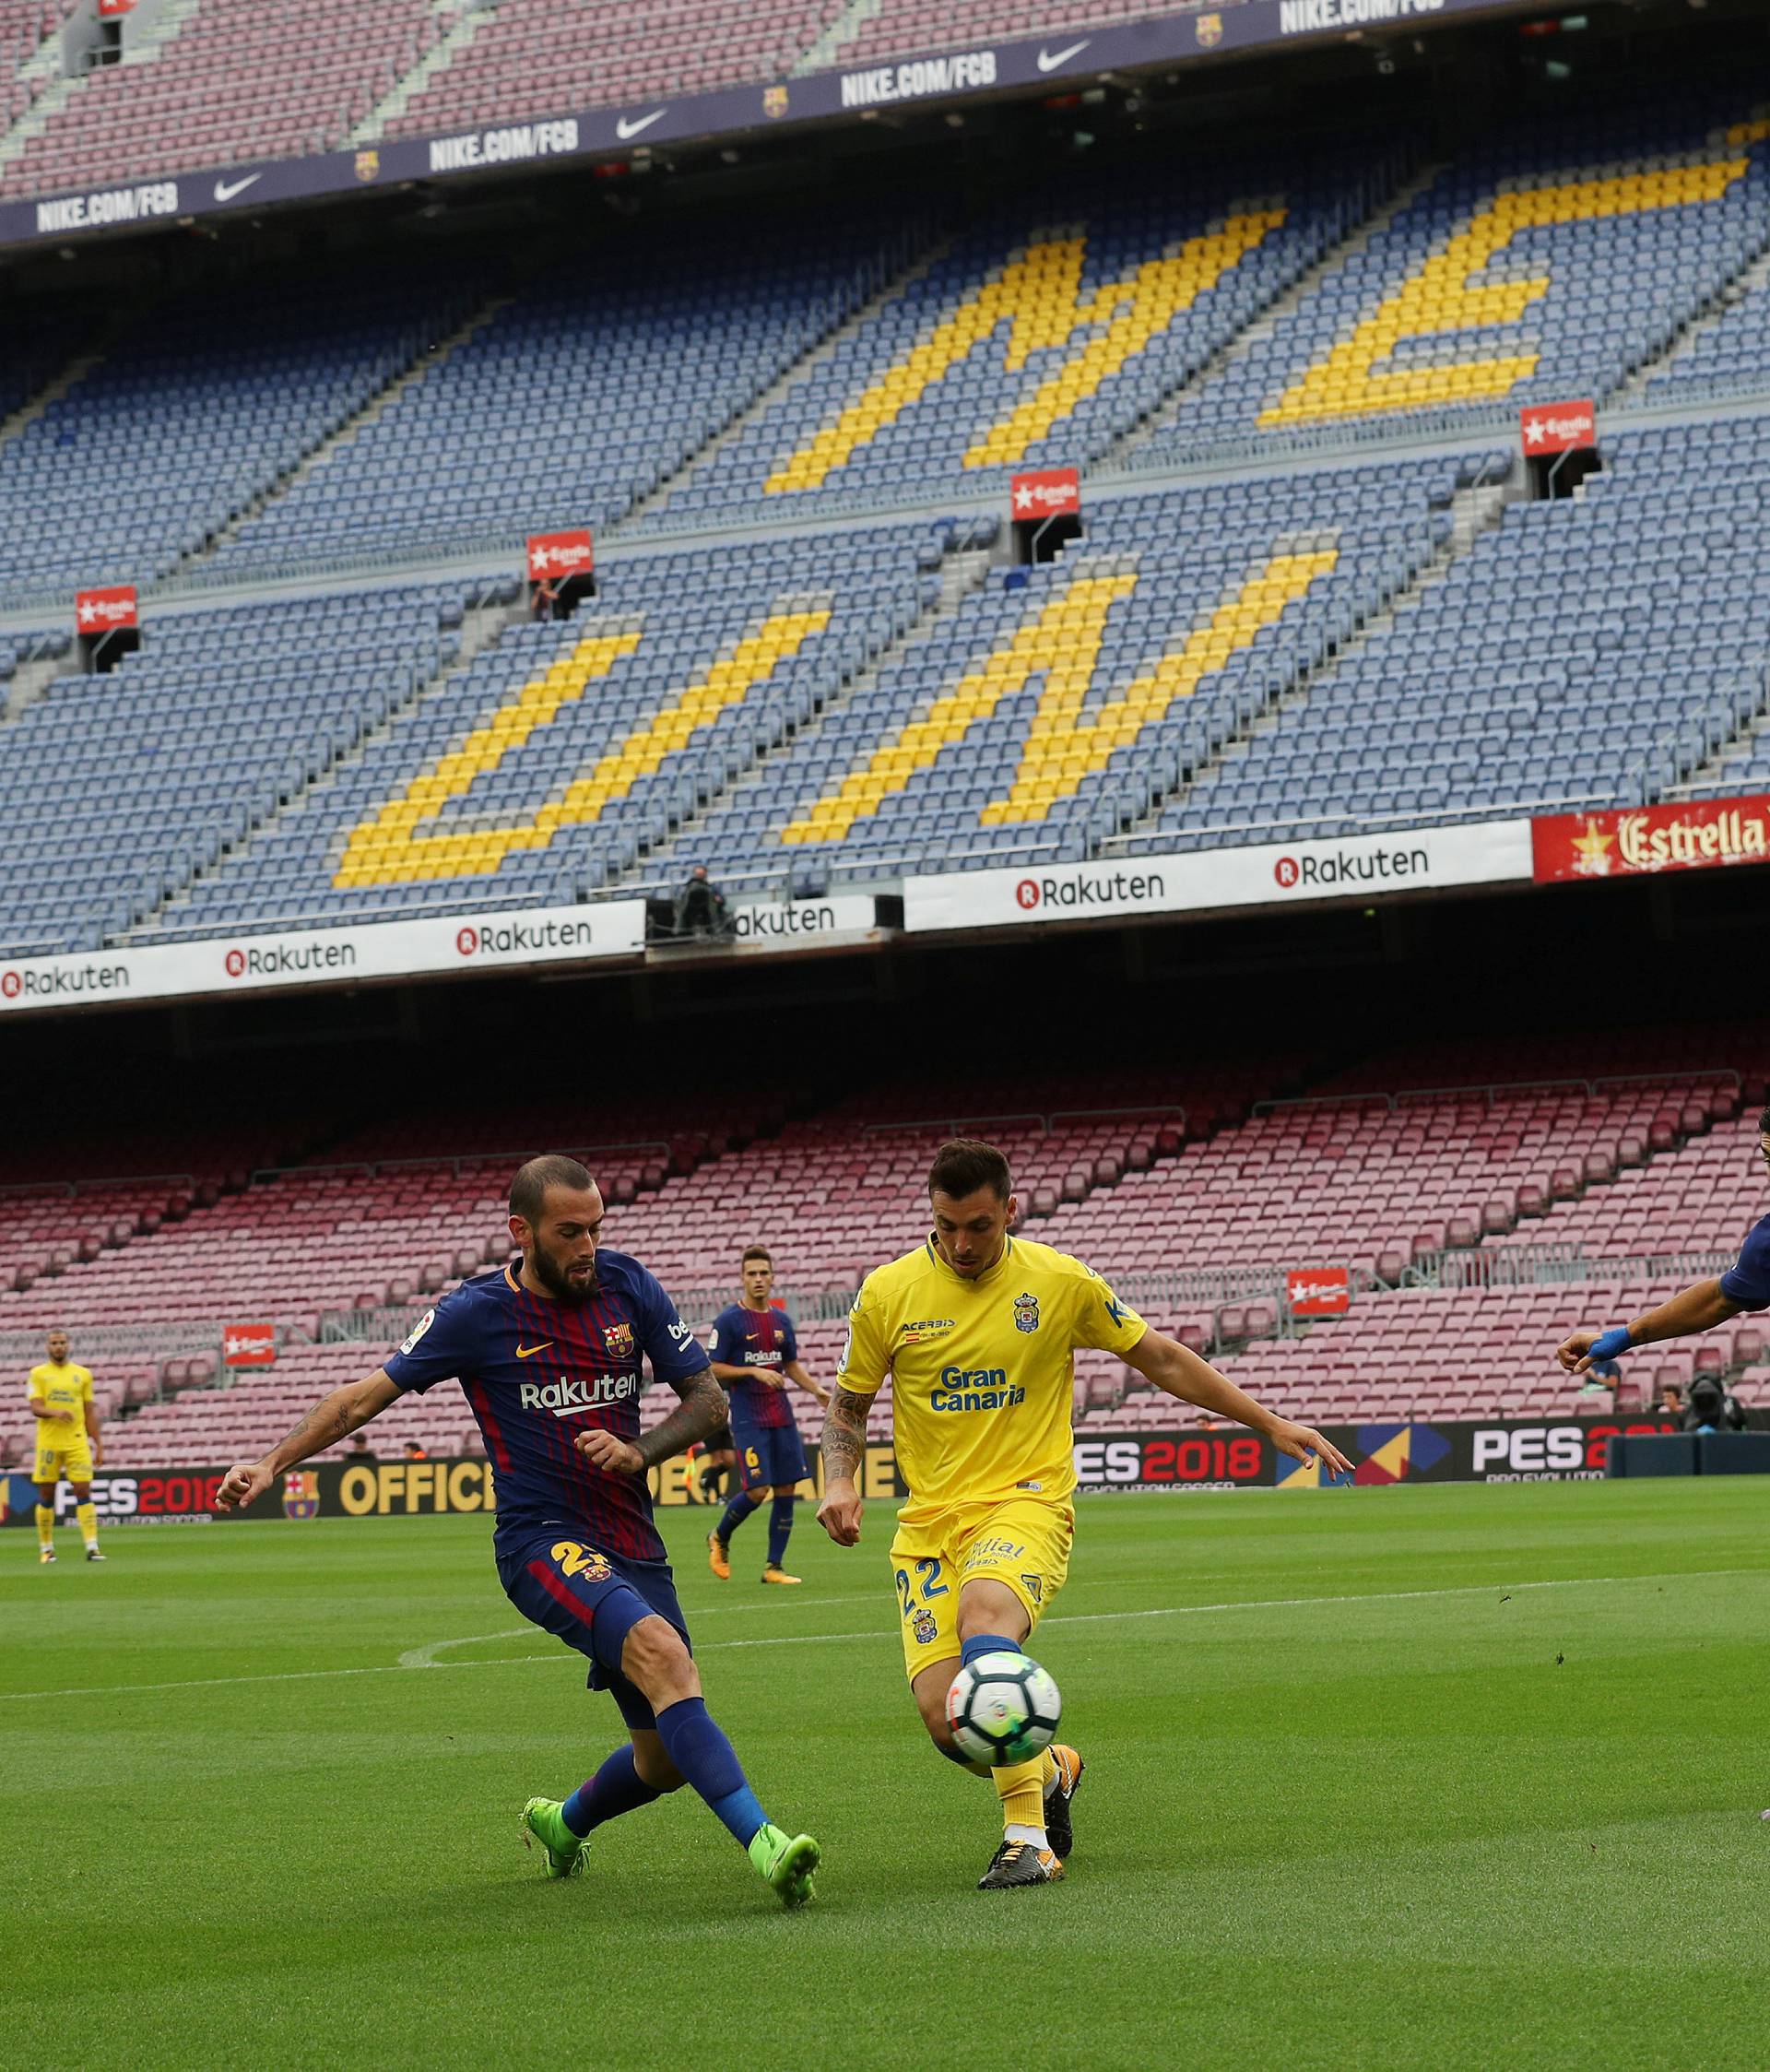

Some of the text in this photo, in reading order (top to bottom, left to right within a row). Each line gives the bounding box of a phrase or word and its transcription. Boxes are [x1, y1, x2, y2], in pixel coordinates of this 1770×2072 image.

[842, 51, 997, 108] NIKE.COM/FCB
[430, 119, 578, 172] NIKE.COM/FCB
[37, 183, 178, 232] NIKE.COM/FCB
[1619, 809, 1765, 867] Estrella
[1302, 848, 1428, 885] Rakuten
[1043, 872, 1164, 907] Rakuten
[480, 919, 591, 953] Rakuten
[737, 904, 834, 937] akuten
[248, 941, 356, 975] Rakuten
[24, 965, 129, 996] Rakuten
[667, 1317, 690, 1340] be
[519, 1372, 636, 1410] Rakuten
[941, 1367, 1006, 1390] Gran
[930, 1384, 1025, 1412] Canaria
[745, 1446, 759, 1468] 6
[1072, 1438, 1262, 1483] ES 2018
[1472, 1427, 1584, 1473] PES
[339, 1462, 497, 1515] OFFICI
[895, 1557, 950, 1618] 22
